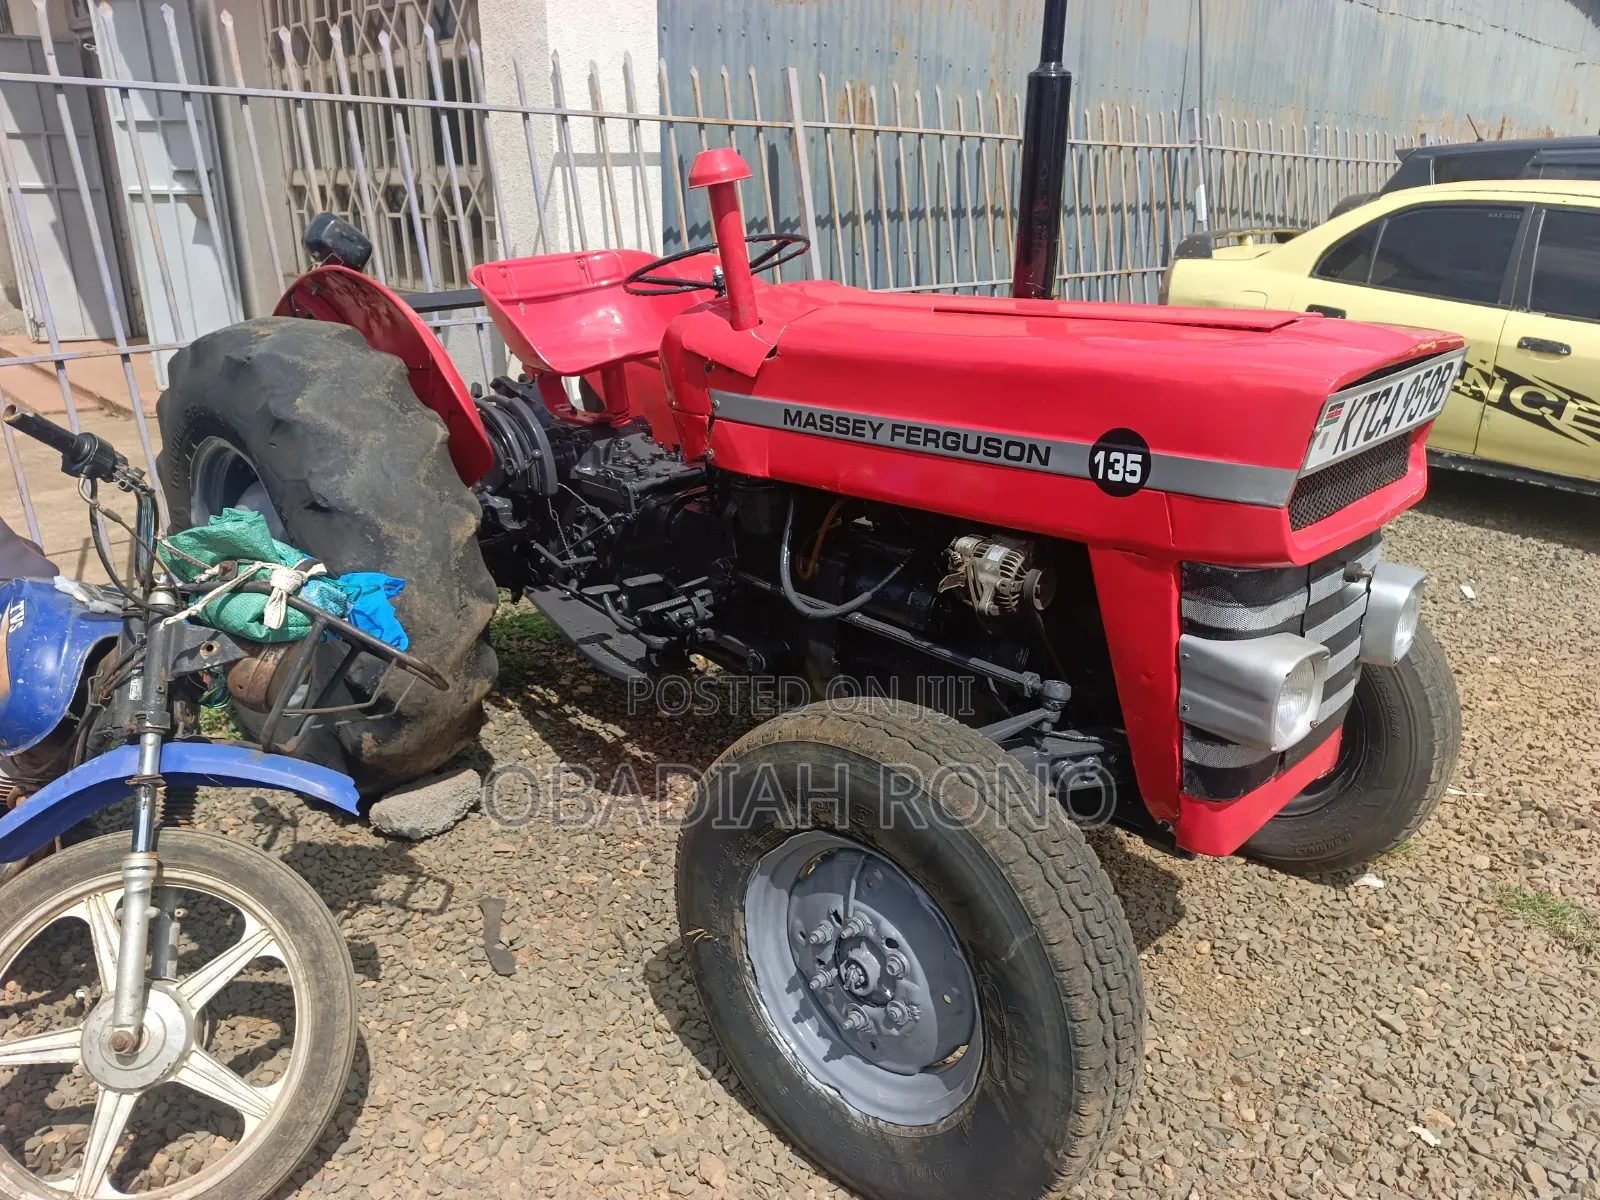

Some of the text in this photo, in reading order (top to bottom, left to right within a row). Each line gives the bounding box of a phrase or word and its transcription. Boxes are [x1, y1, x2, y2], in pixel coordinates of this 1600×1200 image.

[1333, 361, 1455, 455] KTCA 959B
[783, 408, 1051, 467] MASSEY FERGUSON
[1093, 450, 1142, 484] 135
[8, 599, 26, 633] TVS
